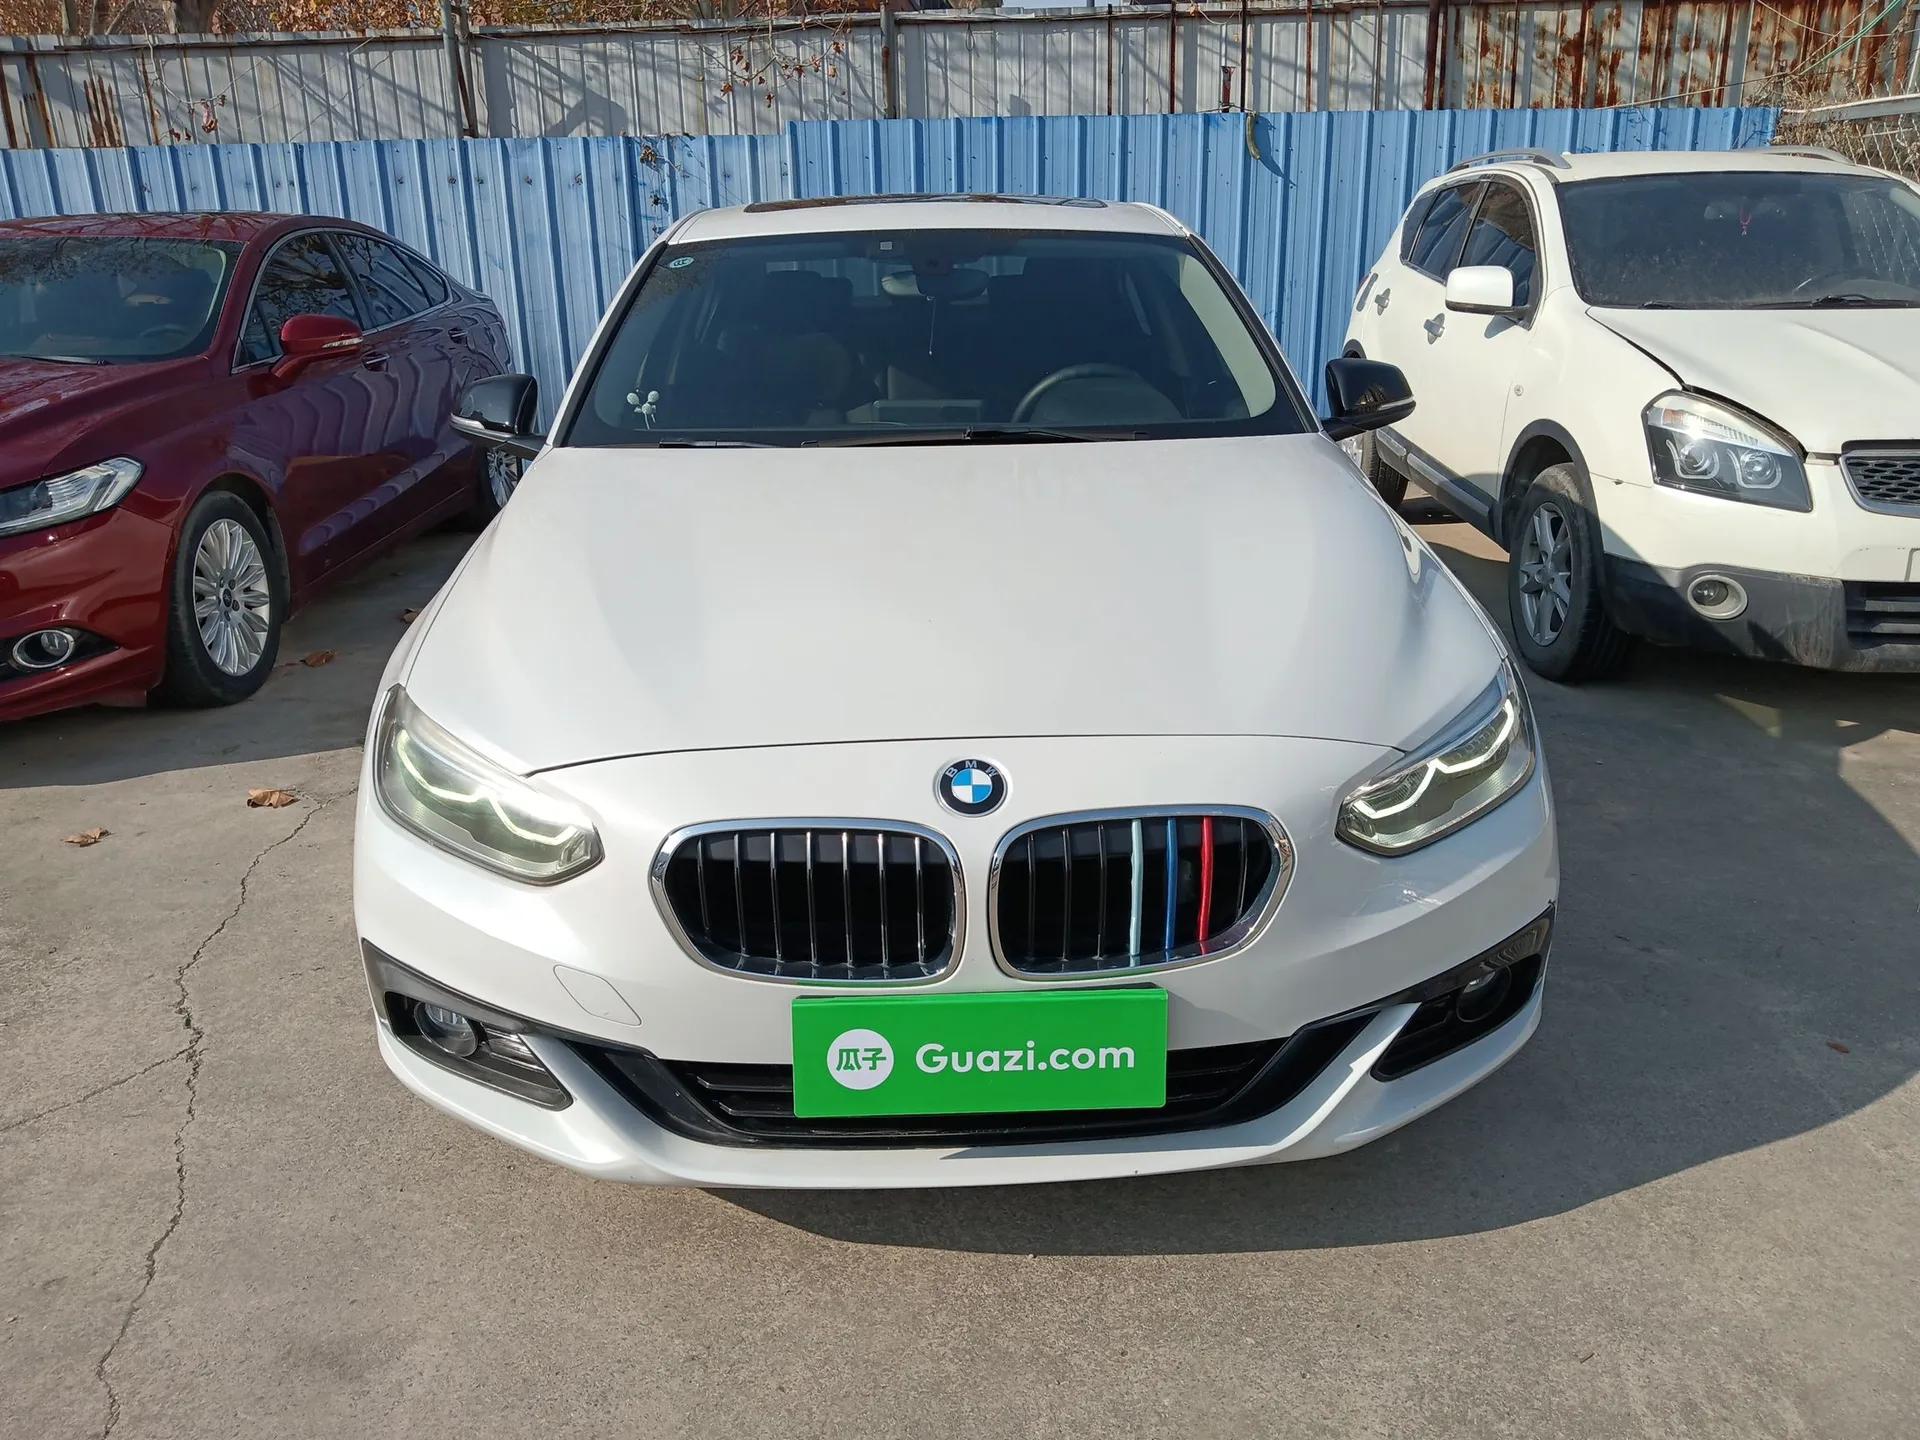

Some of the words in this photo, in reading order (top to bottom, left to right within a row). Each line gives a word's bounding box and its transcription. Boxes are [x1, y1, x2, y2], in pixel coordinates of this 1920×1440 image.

[945, 760, 999, 778] BMW
[835, 1047, 887, 1071] 瓜子
[915, 1040, 1135, 1074] Guazi.com
